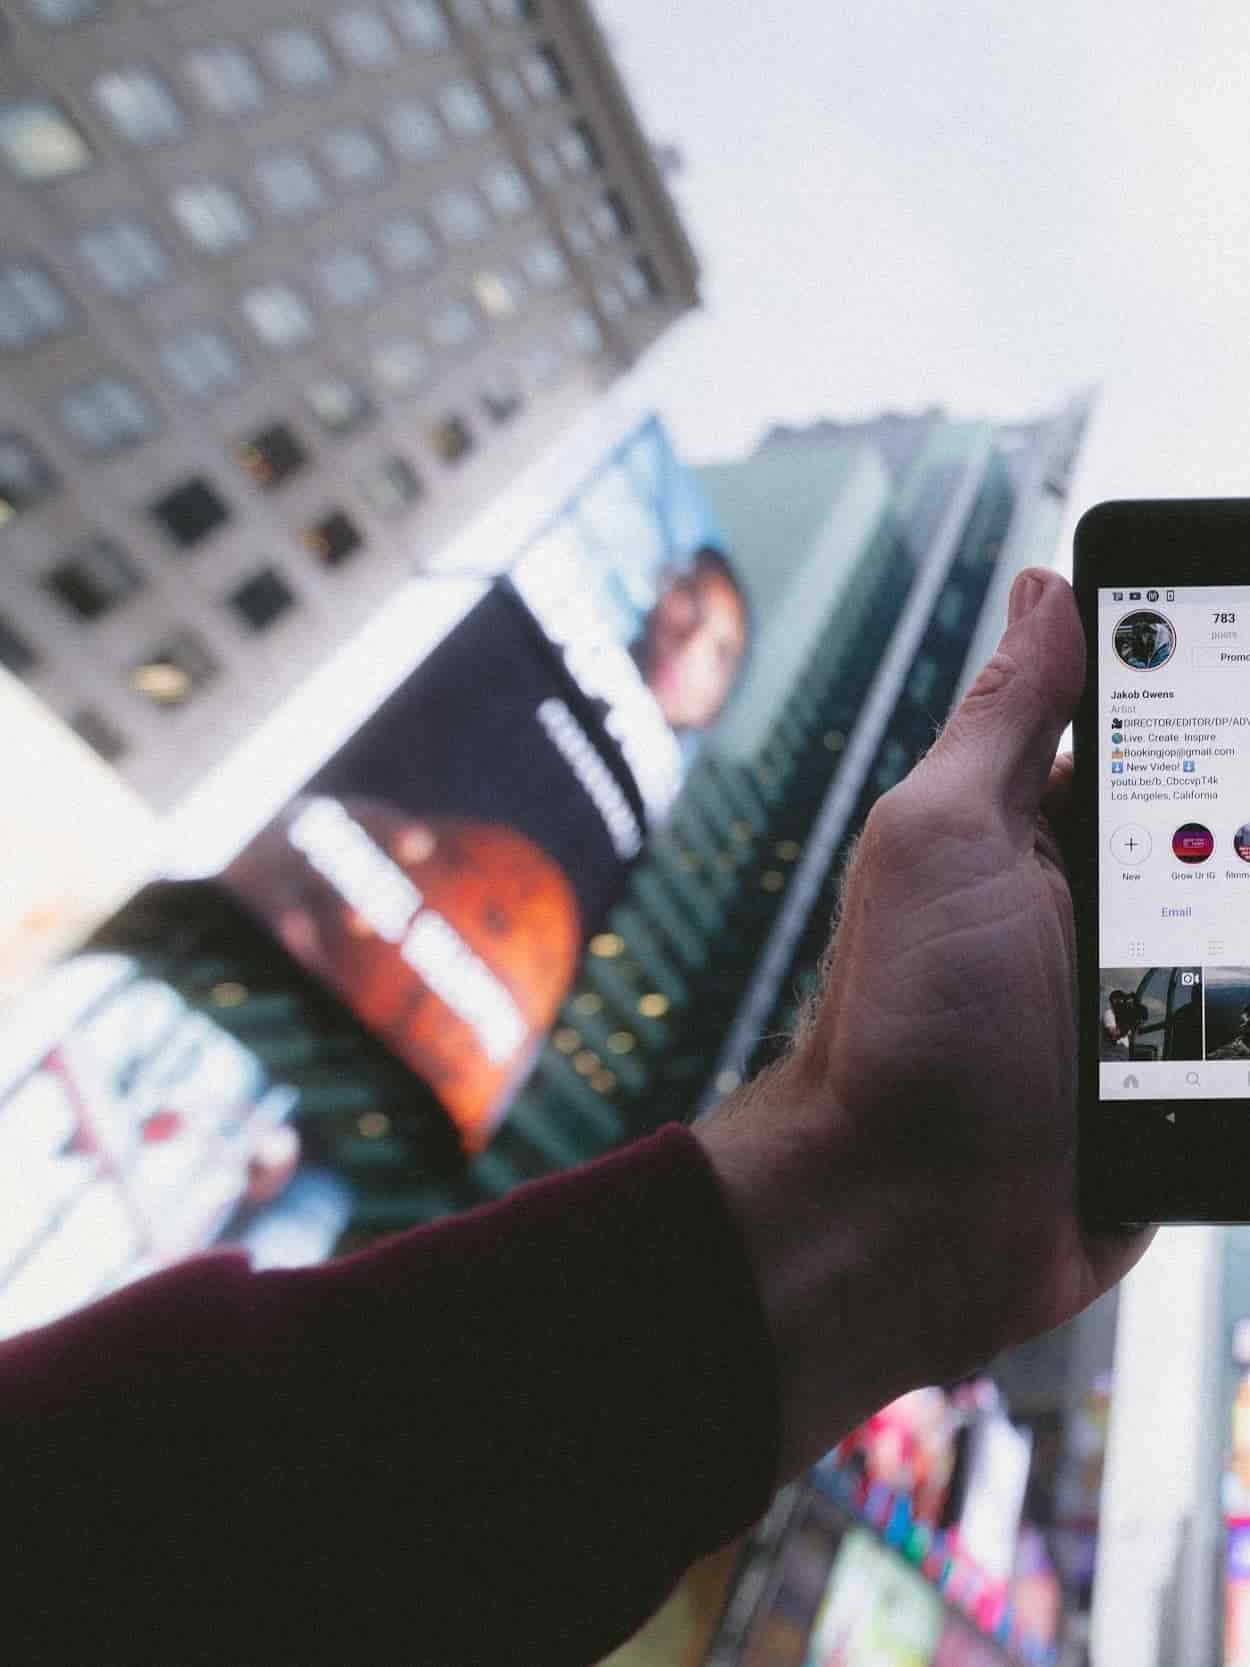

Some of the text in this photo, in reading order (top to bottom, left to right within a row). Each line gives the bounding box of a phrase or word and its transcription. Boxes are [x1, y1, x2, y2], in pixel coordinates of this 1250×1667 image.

[1211, 613, 1236, 624] 783
[1110, 689, 1174, 700] Jakob Owens
[1111, 704, 1136, 713] Artist
[1127, 762, 1180, 772] New Video!
[1111, 791, 1128, 801] Los
[1173, 790, 1218, 801] California
[1122, 872, 1141, 881] New
[1171, 871, 1193, 880] Grow
[1161, 906, 1192, 918] Email
